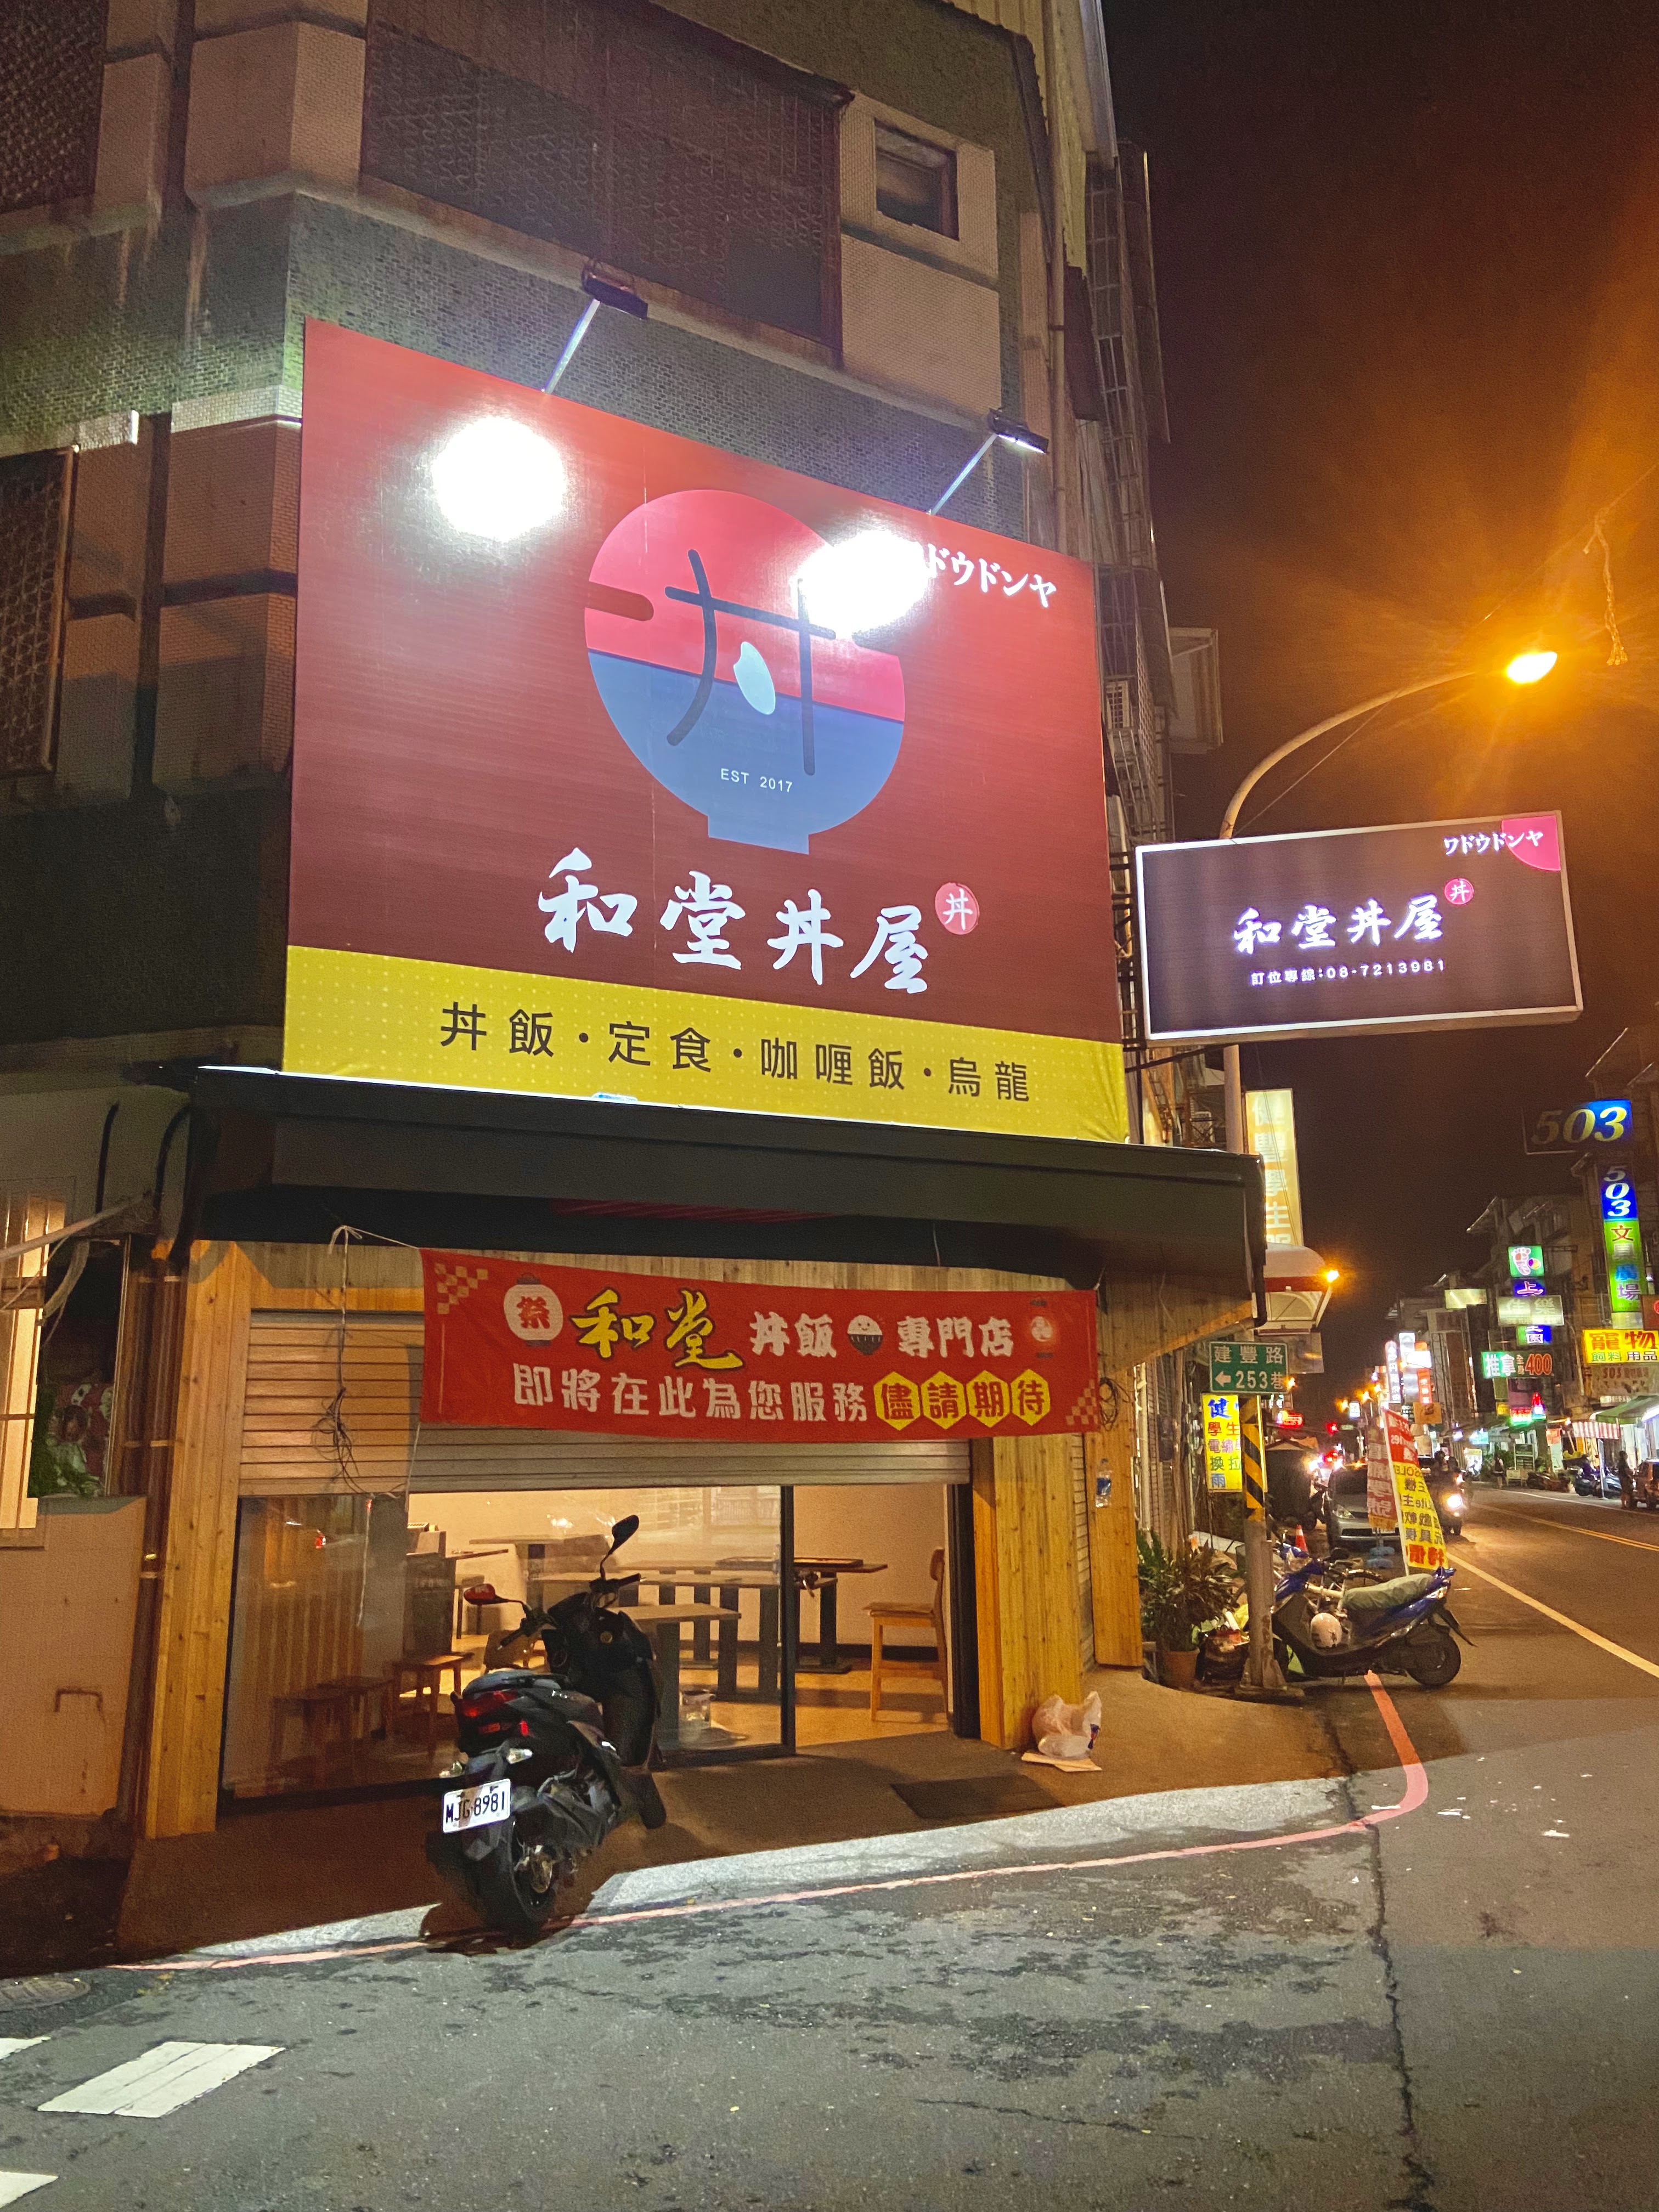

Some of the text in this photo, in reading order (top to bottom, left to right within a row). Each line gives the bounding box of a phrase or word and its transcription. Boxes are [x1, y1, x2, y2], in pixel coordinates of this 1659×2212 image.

[928, 543, 1056, 608] ドウドンヤ
[721, 768, 792, 793] EST 2017
[1443, 830, 1543, 855] ワドウドンヤ
[538, 848, 928, 993] 和堂丼屋
[1233, 893, 1444, 955] 和堂丼屋
[1531, 1107, 1627, 1143] 503
[571, 1289, 743, 1369] 和堂
[749, 1310, 837, 1358] 丼飯
[897, 1315, 1013, 1359] 專門店
[1214, 1345, 1284, 1364] 建豐路
[1484, 1353, 1516, 1376] 推拿
[1525, 1353, 1553, 1375] 400
[1210, 1455, 1242, 1471] 換拉
